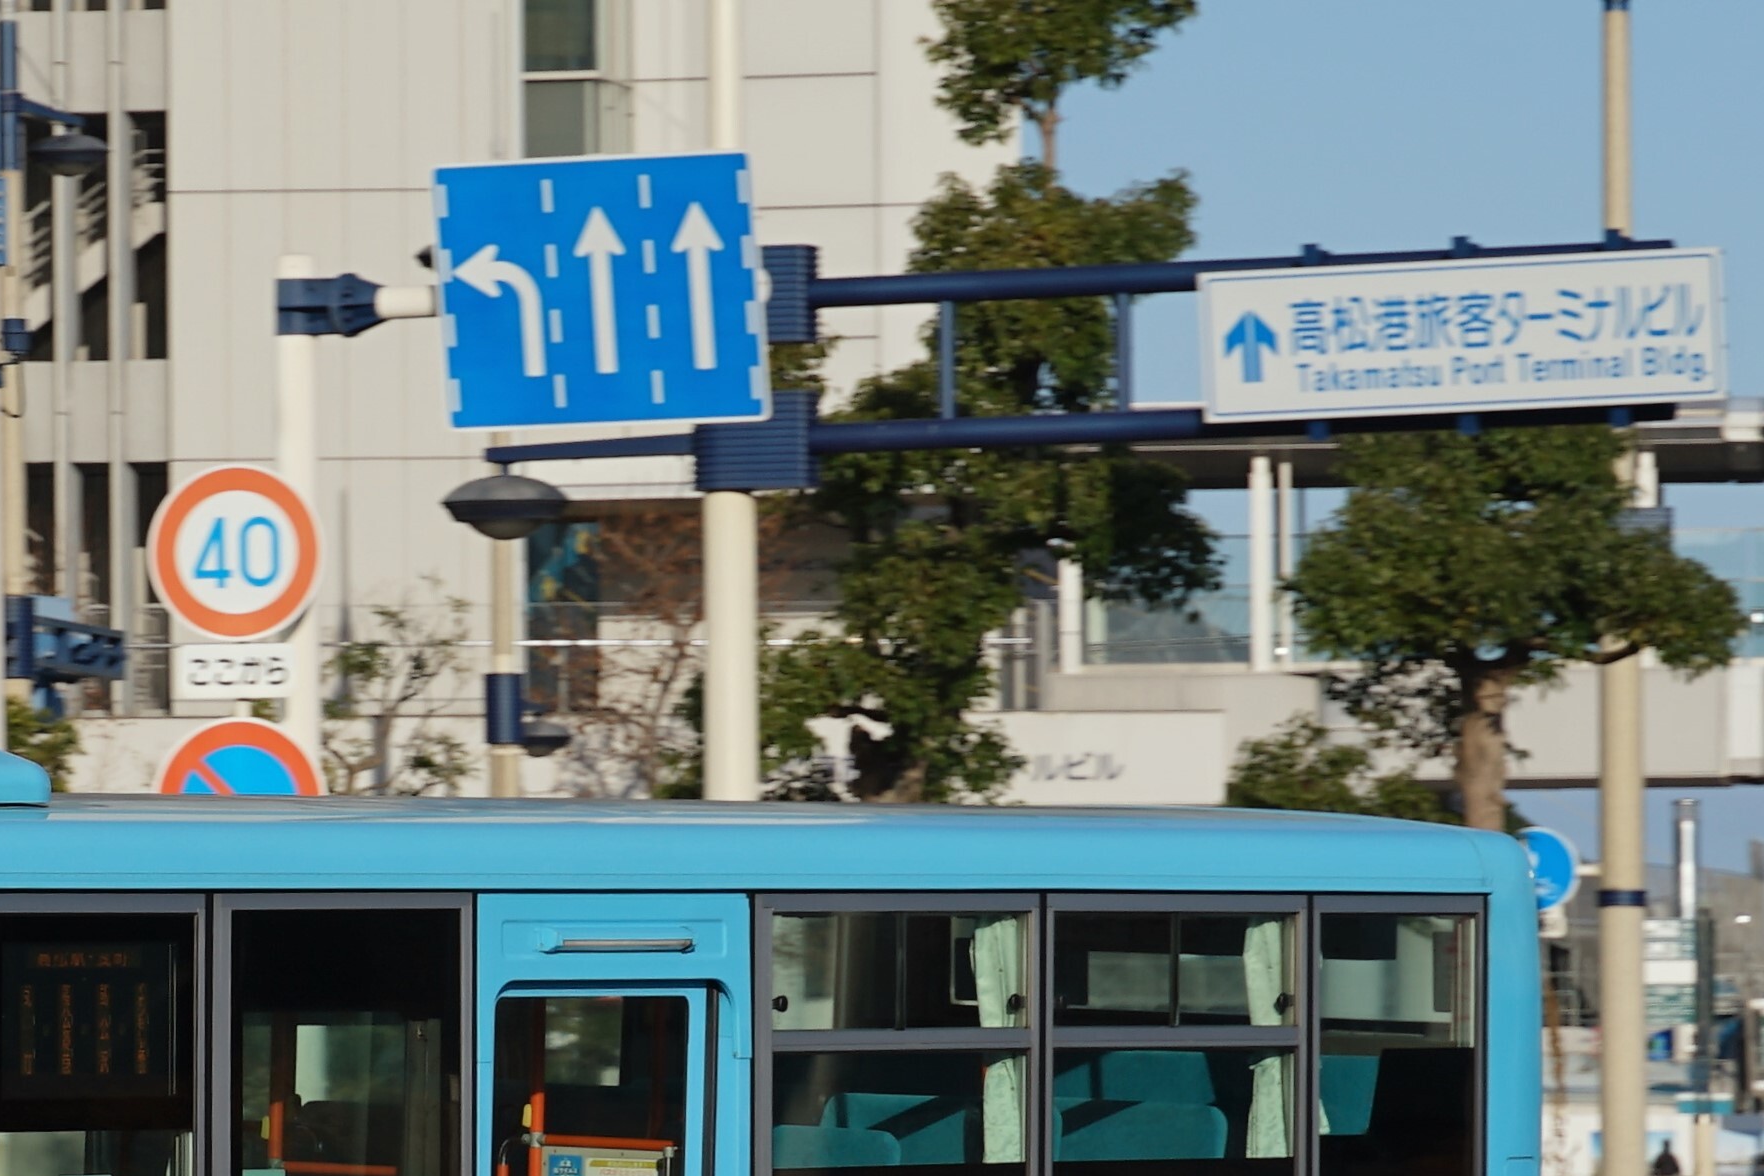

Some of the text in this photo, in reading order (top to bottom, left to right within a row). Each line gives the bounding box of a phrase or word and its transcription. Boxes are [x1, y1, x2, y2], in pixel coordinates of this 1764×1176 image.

[1288, 283, 1706, 356] 高松港旅客ターミナルビル
[1296, 357, 1443, 392] Takamatsu
[1450, 353, 1507, 385] Port
[1515, 348, 1633, 382] Terminal
[194, 516, 280, 588] 40
[188, 656, 290, 685] ここから
